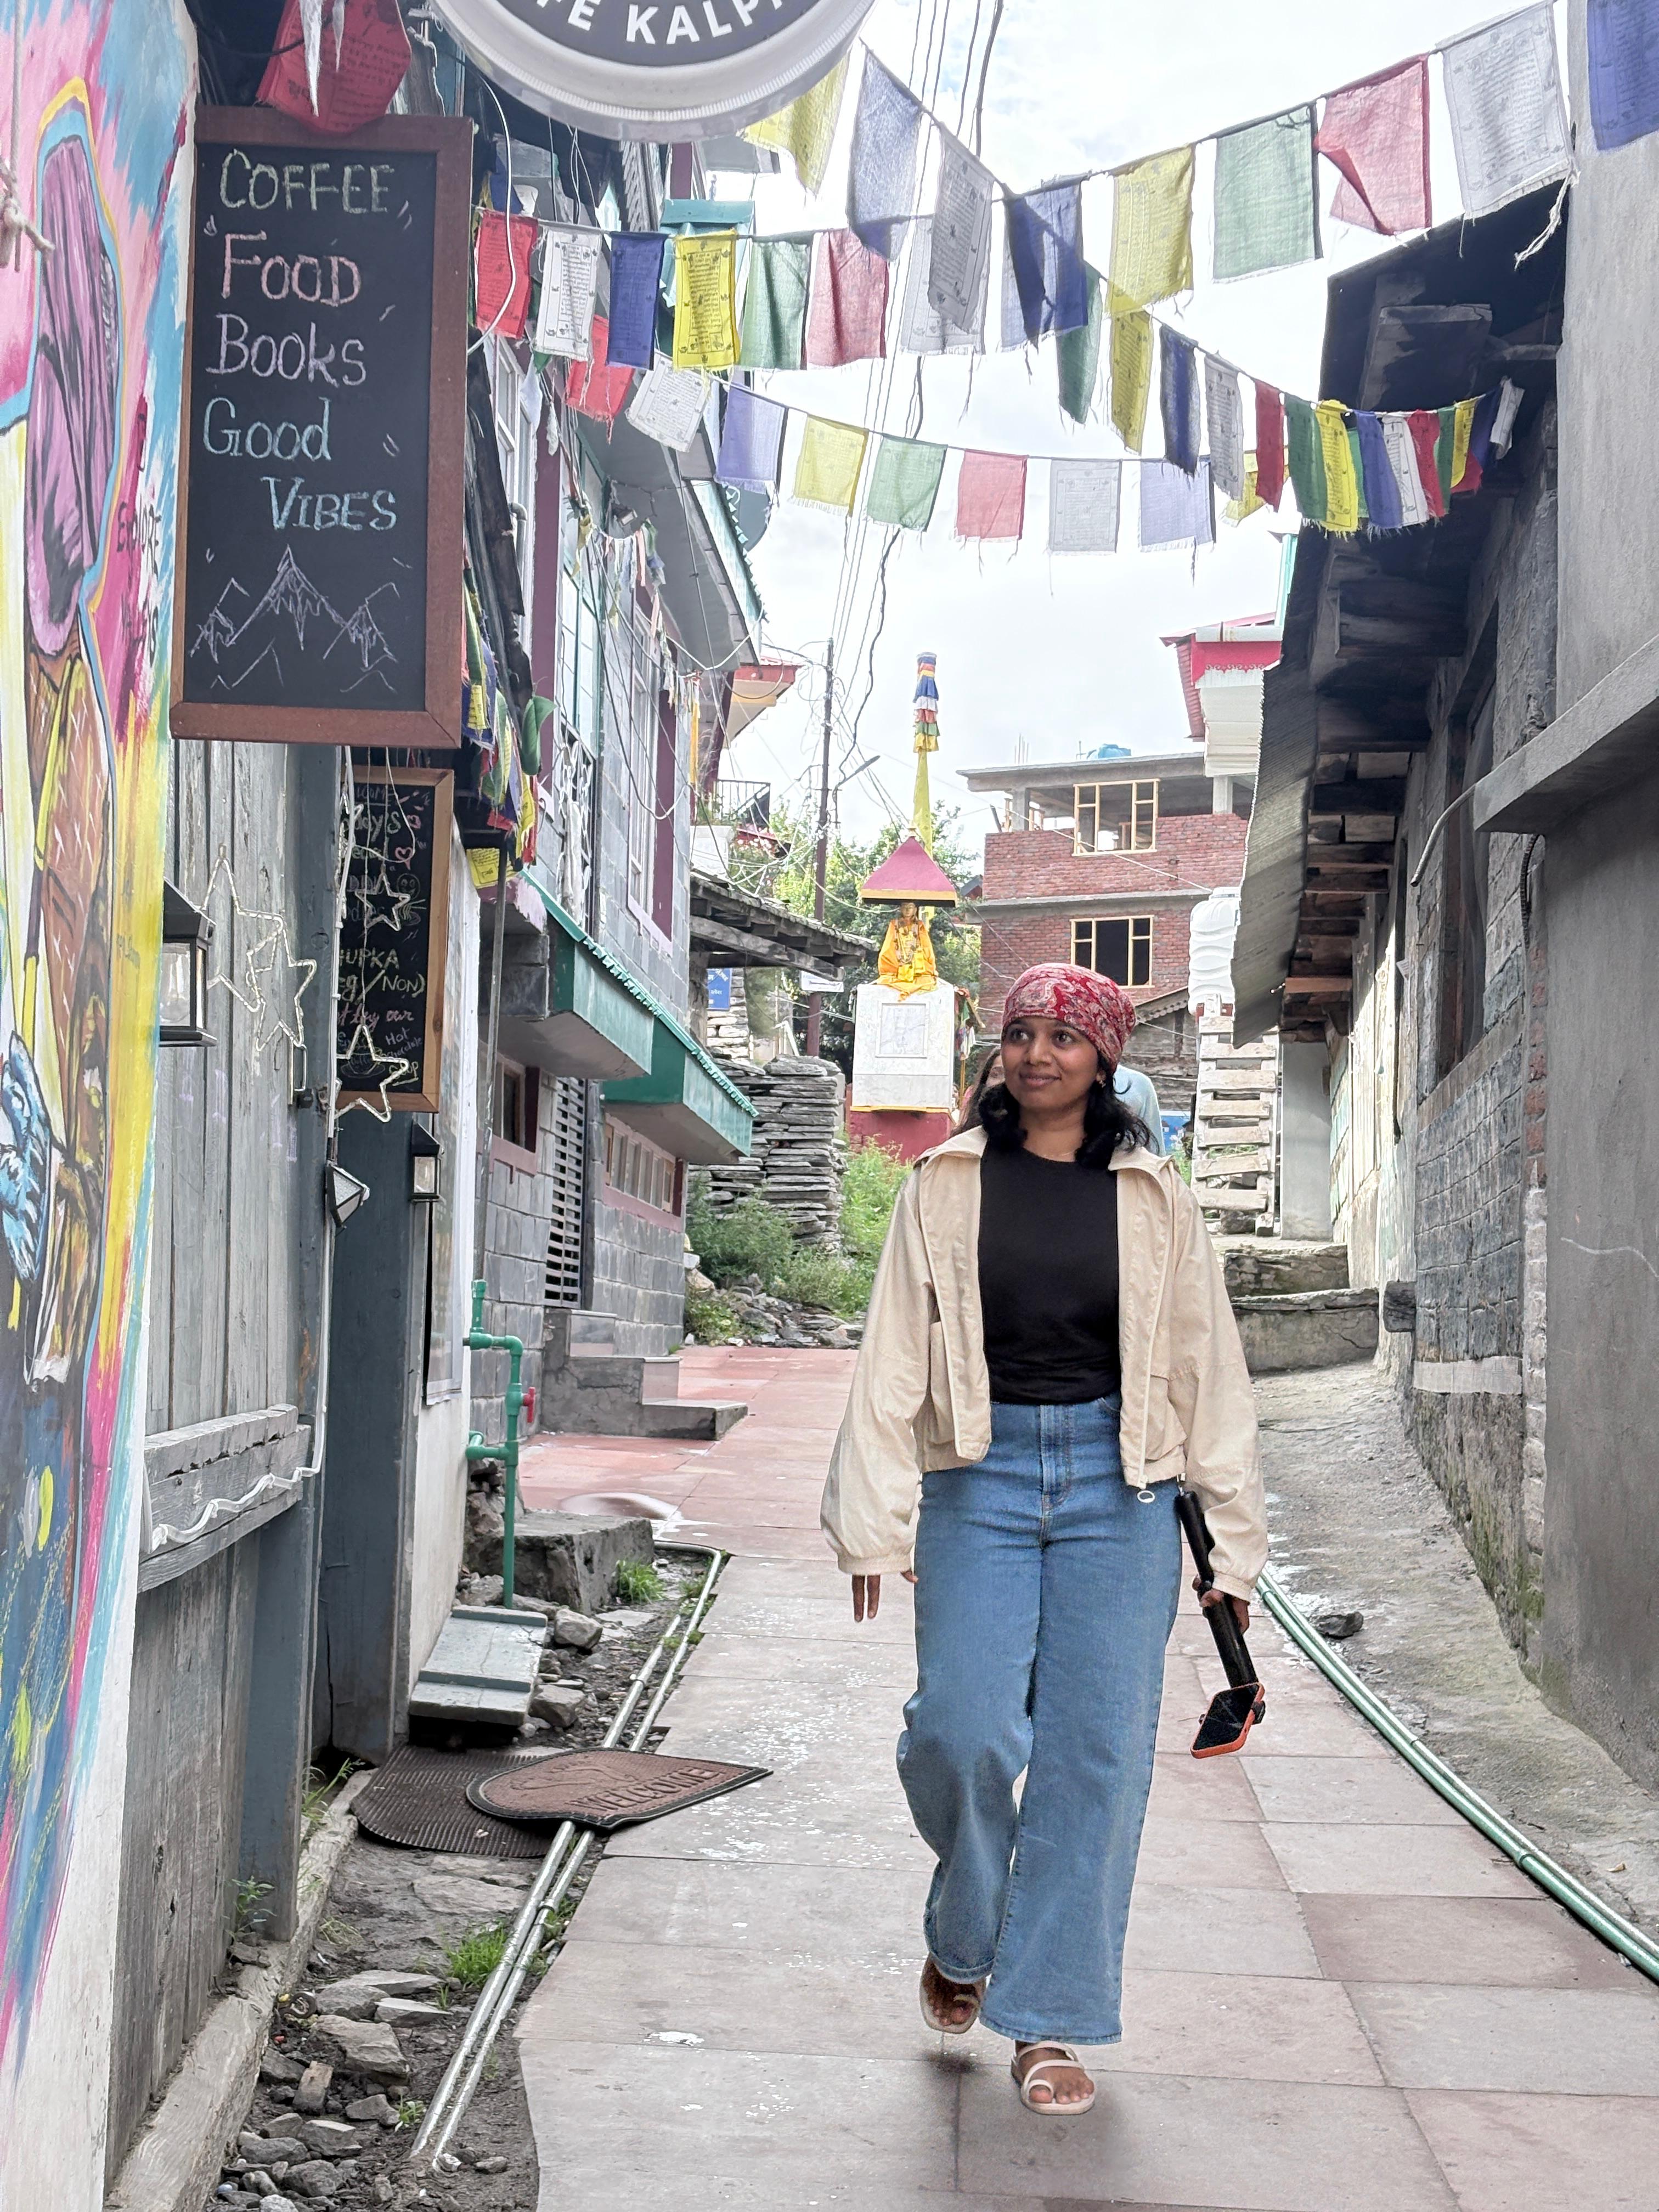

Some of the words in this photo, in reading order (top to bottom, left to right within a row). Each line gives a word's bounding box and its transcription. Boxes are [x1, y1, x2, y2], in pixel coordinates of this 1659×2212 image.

[626, 0, 783, 45] KALP
[219, 148, 394, 214] COFFEE
[202, 397, 332, 461] Good
[338, 947, 400, 970] HUPKA
[385, 1027, 410, 1045] Hot
[564, 1766, 720, 1811] WELCOME
